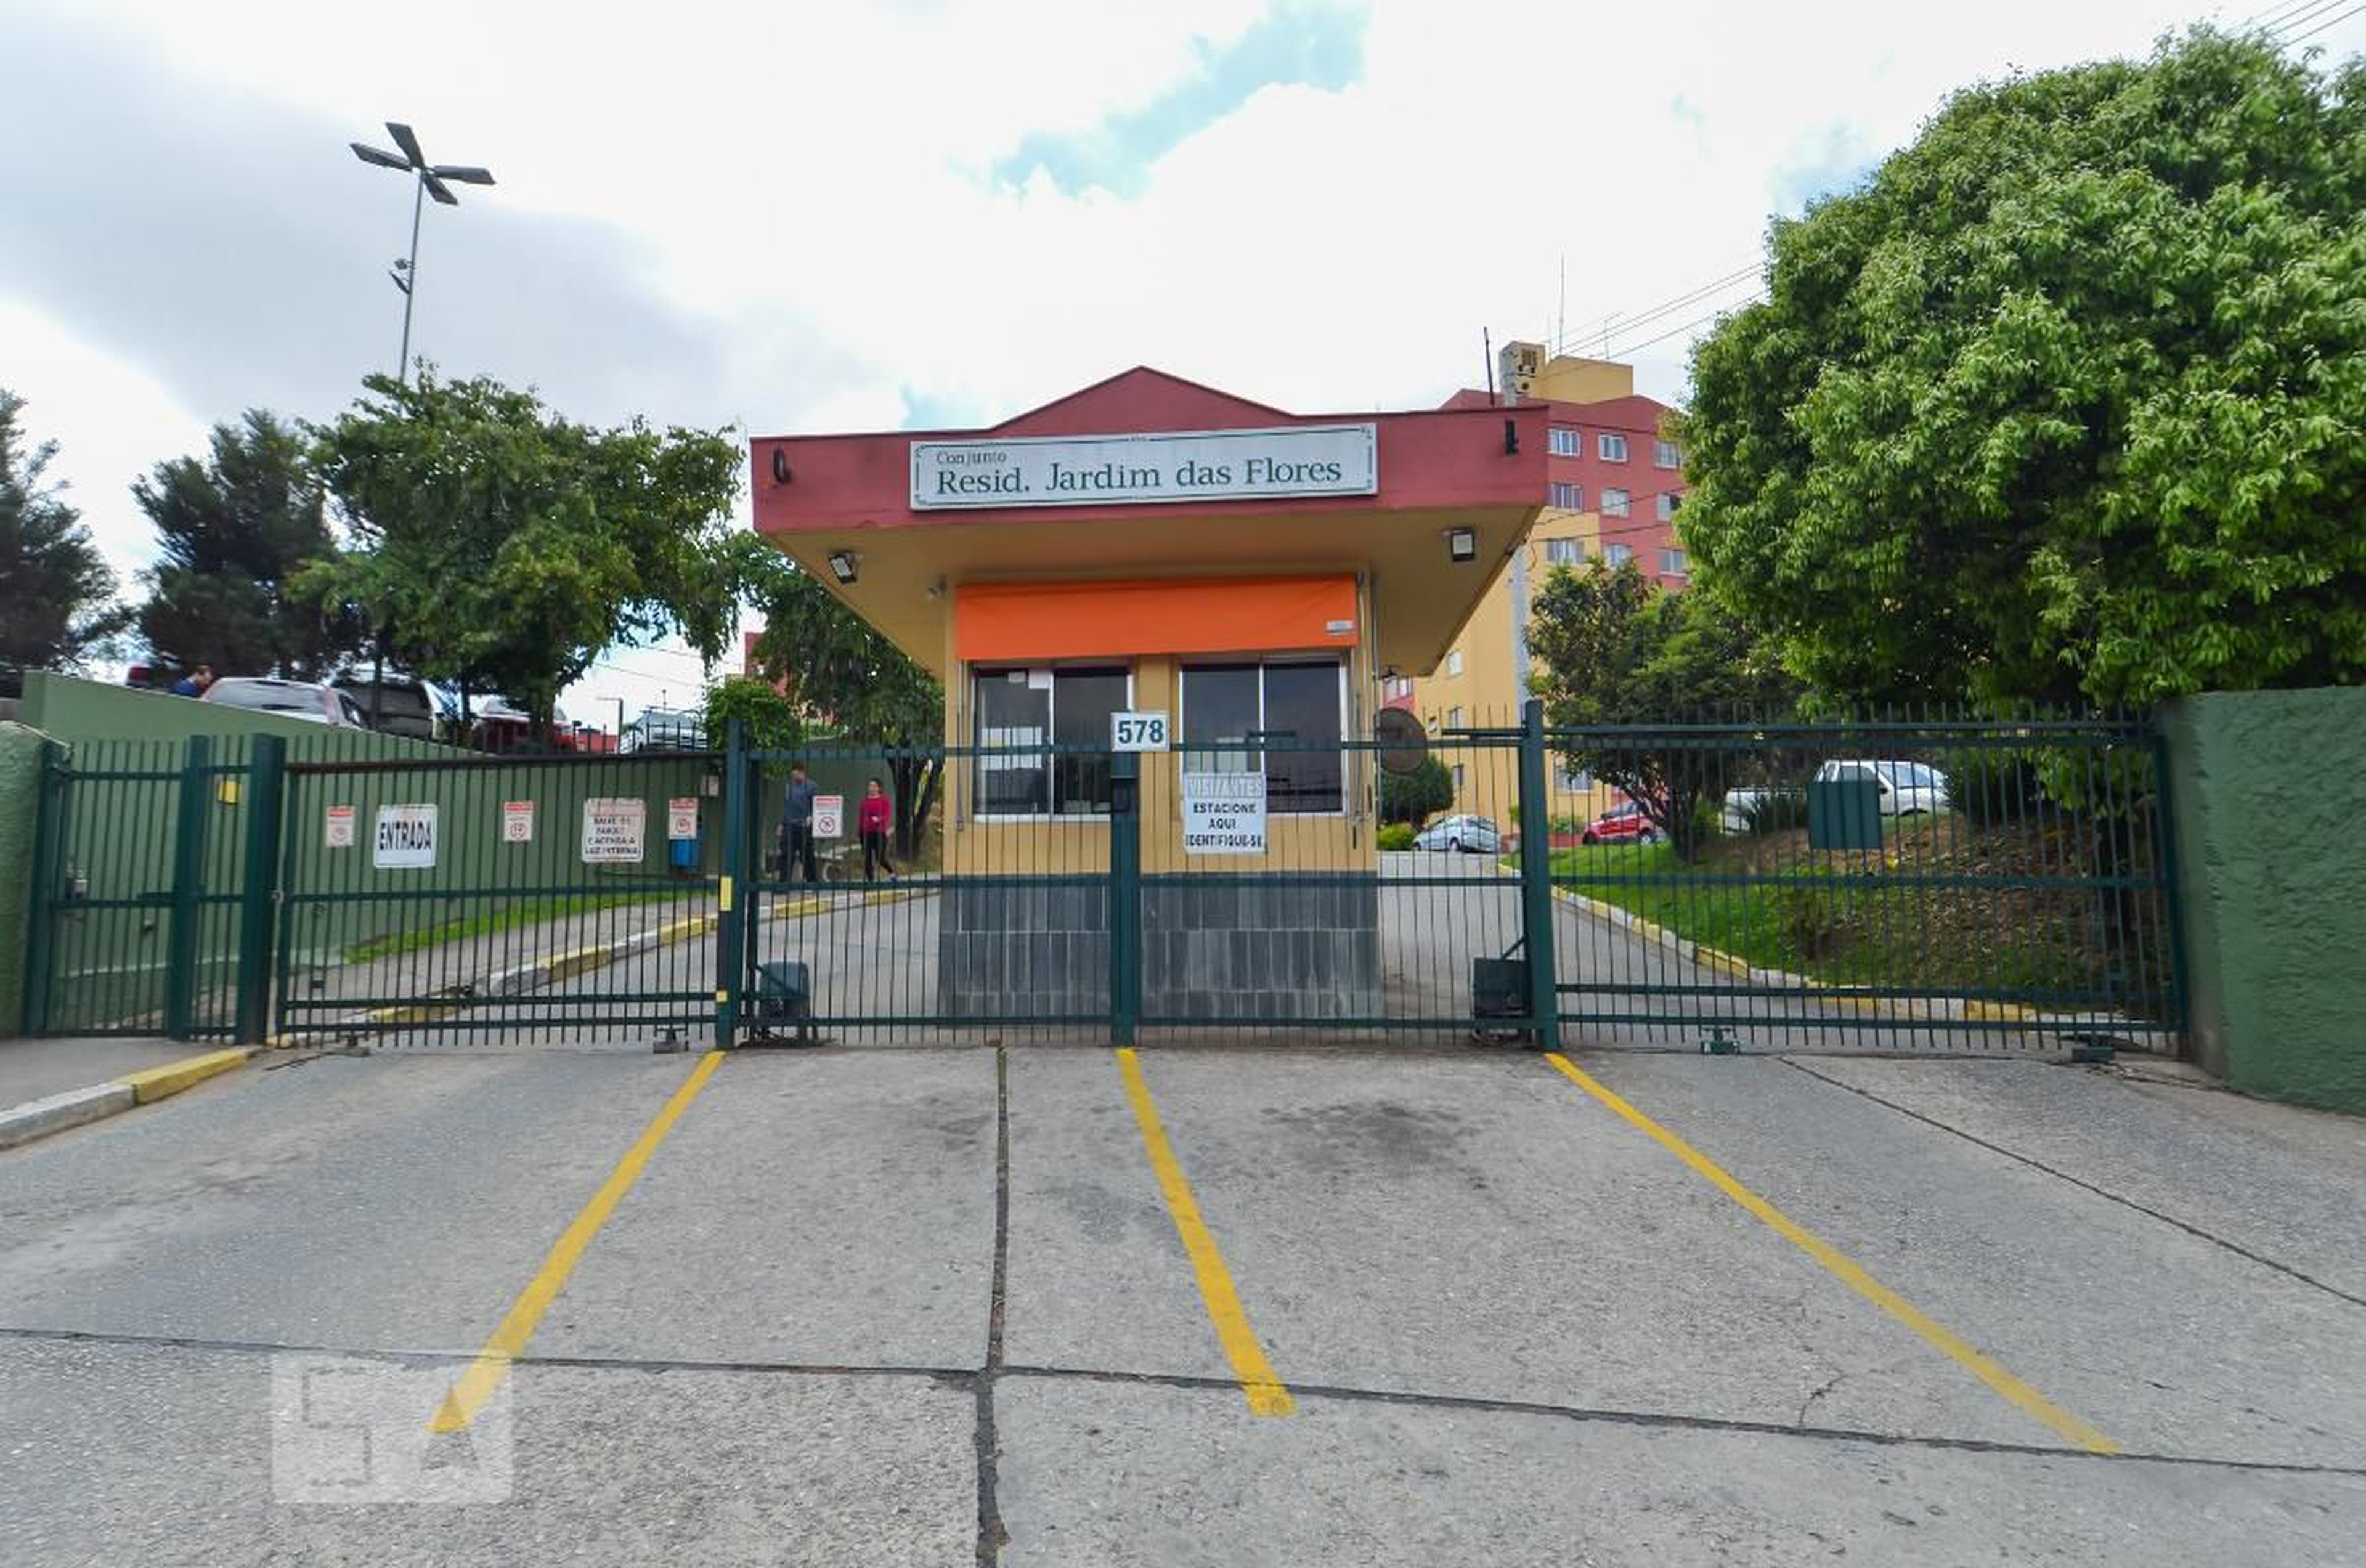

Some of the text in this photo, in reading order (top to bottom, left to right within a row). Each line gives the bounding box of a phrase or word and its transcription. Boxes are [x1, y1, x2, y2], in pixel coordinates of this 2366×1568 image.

[936, 450, 1007, 466] Conjunto
[937, 457, 1343, 494] Resid. Jardim das Flores
[1117, 720, 1165, 744] 578
[1193, 803, 1257, 814] ESTACIONE
[1208, 818, 1237, 829] AQUI
[379, 820, 432, 850] ENTRADA
